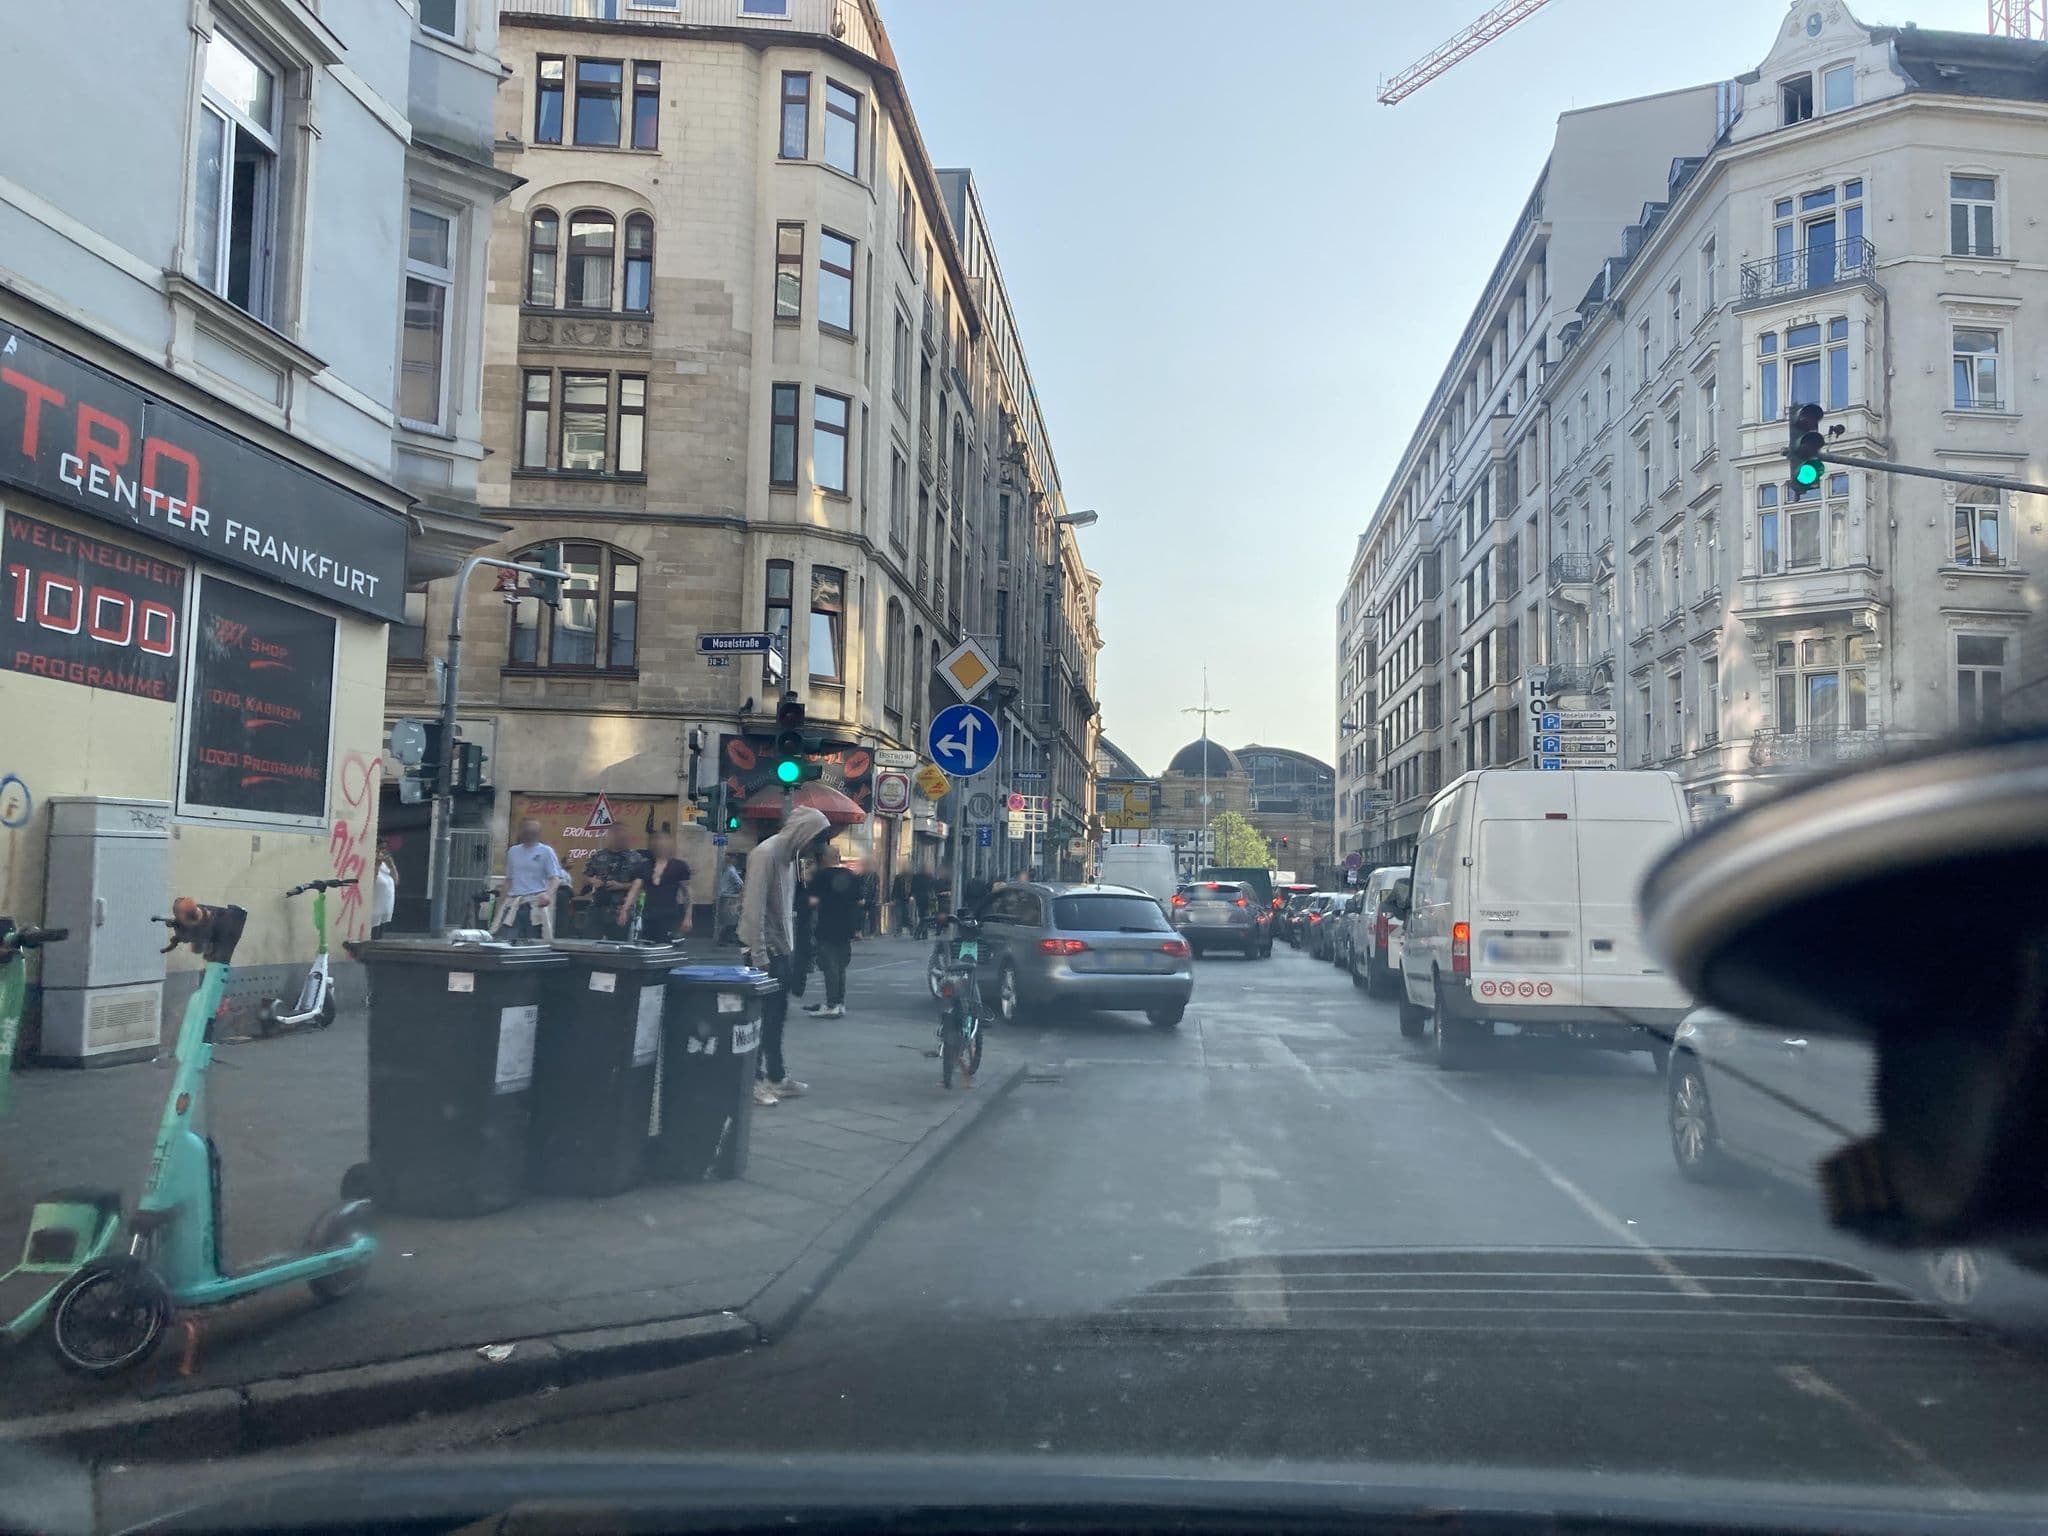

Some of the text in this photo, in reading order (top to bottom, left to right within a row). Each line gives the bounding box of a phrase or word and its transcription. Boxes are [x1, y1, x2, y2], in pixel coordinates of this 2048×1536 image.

[59, 452, 380, 599] CENTER FRANKFURT
[8, 519, 184, 586] WELTNEUHEIT
[9, 563, 176, 658] 1000
[250, 638, 289, 658] SHOP
[712, 637, 760, 649] Moselstraße
[14, 652, 166, 699] PROGRAMME
[199, 747, 321, 781] 1000 PROGRAMME
